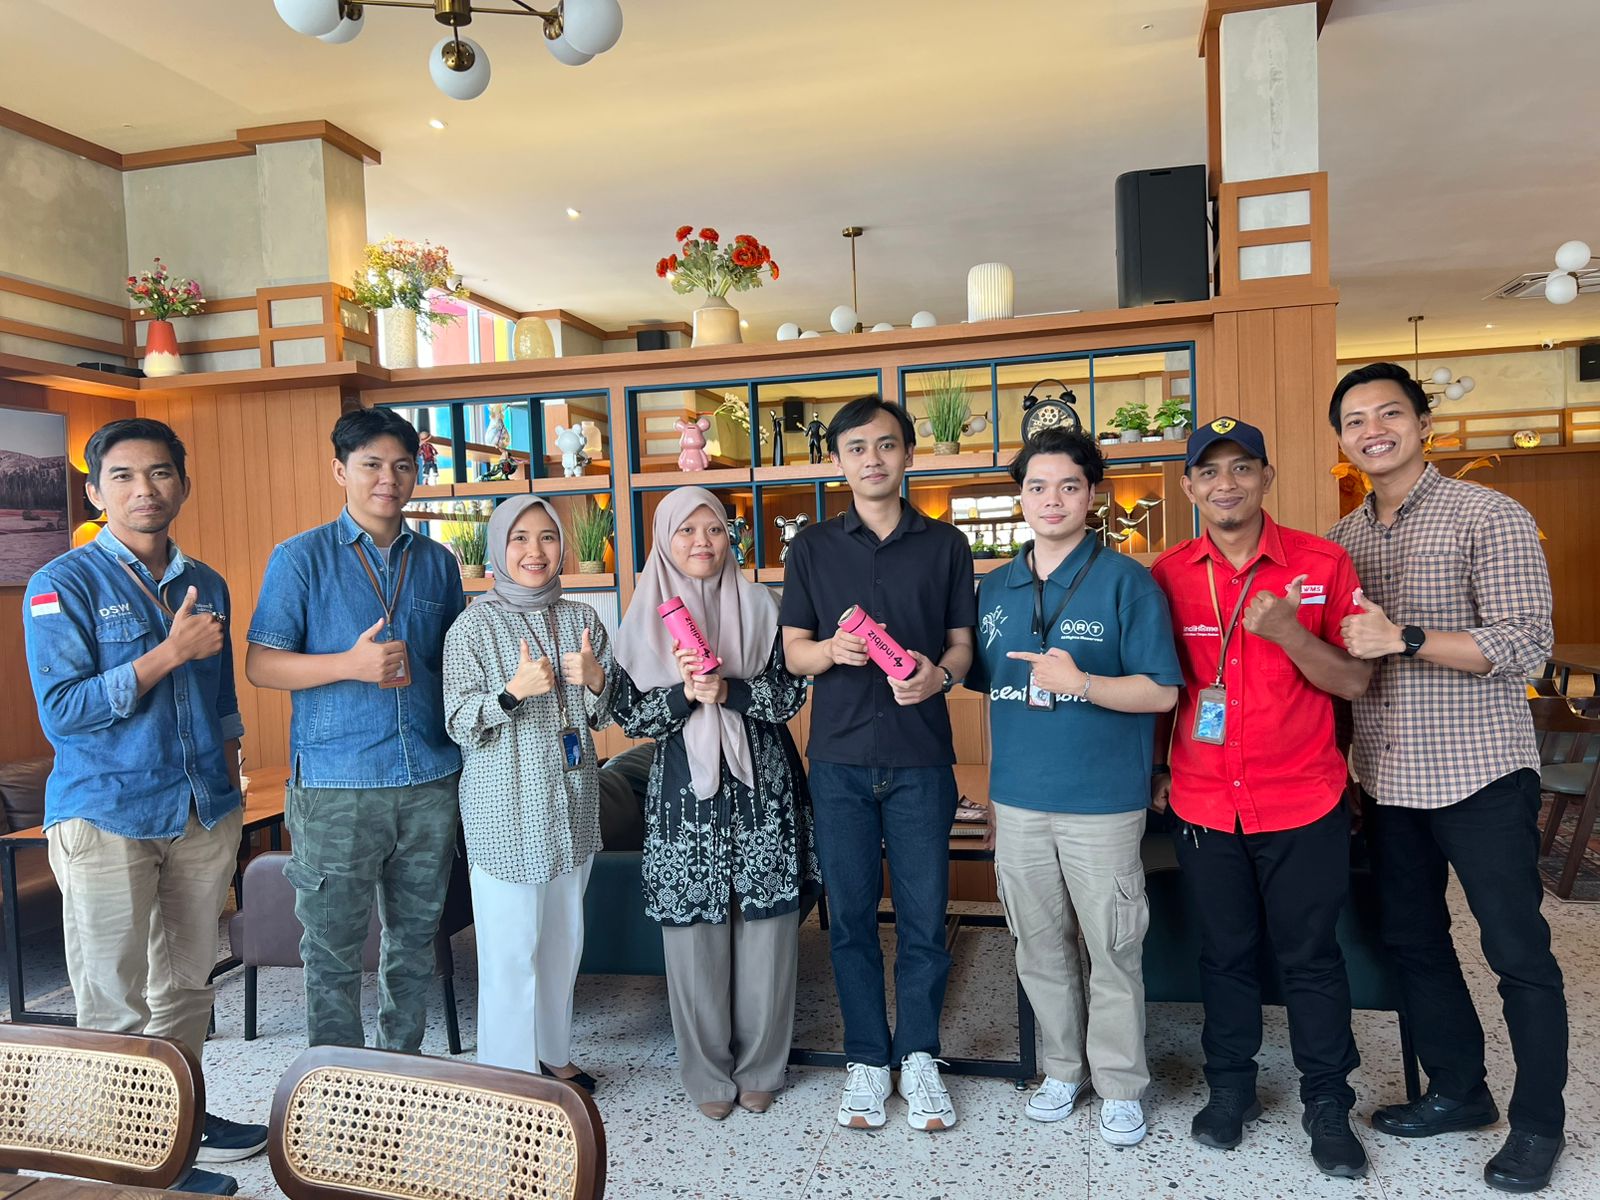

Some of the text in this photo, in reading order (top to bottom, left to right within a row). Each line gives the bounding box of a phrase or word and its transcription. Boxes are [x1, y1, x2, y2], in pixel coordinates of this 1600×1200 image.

[99, 602, 130, 617] DSW
[685, 616, 706, 648] indibiz
[1061, 621, 1103, 635] ART
[867, 629, 896, 659] indibiz
